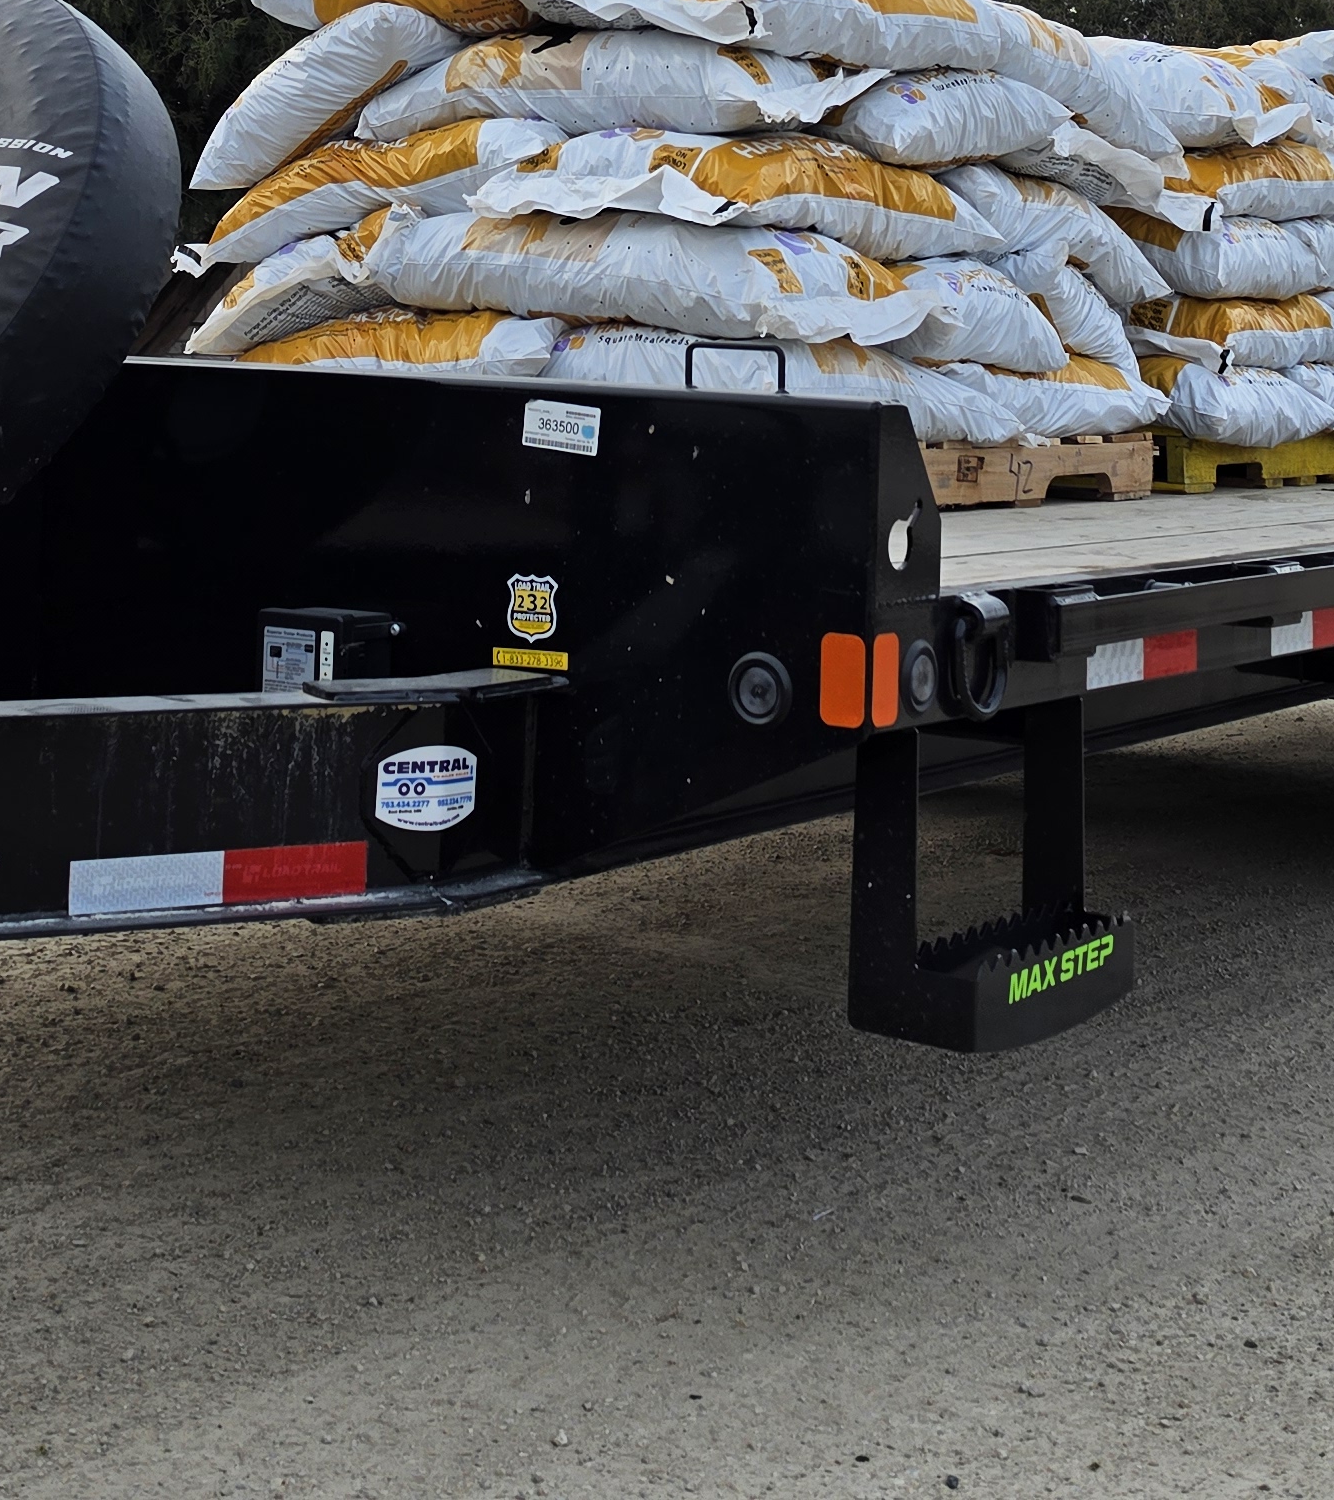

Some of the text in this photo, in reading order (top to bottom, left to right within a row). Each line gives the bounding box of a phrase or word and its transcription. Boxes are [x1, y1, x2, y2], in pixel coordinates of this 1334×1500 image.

[538, 417, 579, 435] 363500
[515, 581, 551, 592] LOAD TRAIL
[517, 594, 547, 611] 232
[513, 612, 551, 622] PROTECTED
[383, 757, 470, 775] CENTRAL
[1008, 934, 1114, 1004] MAX STEP
